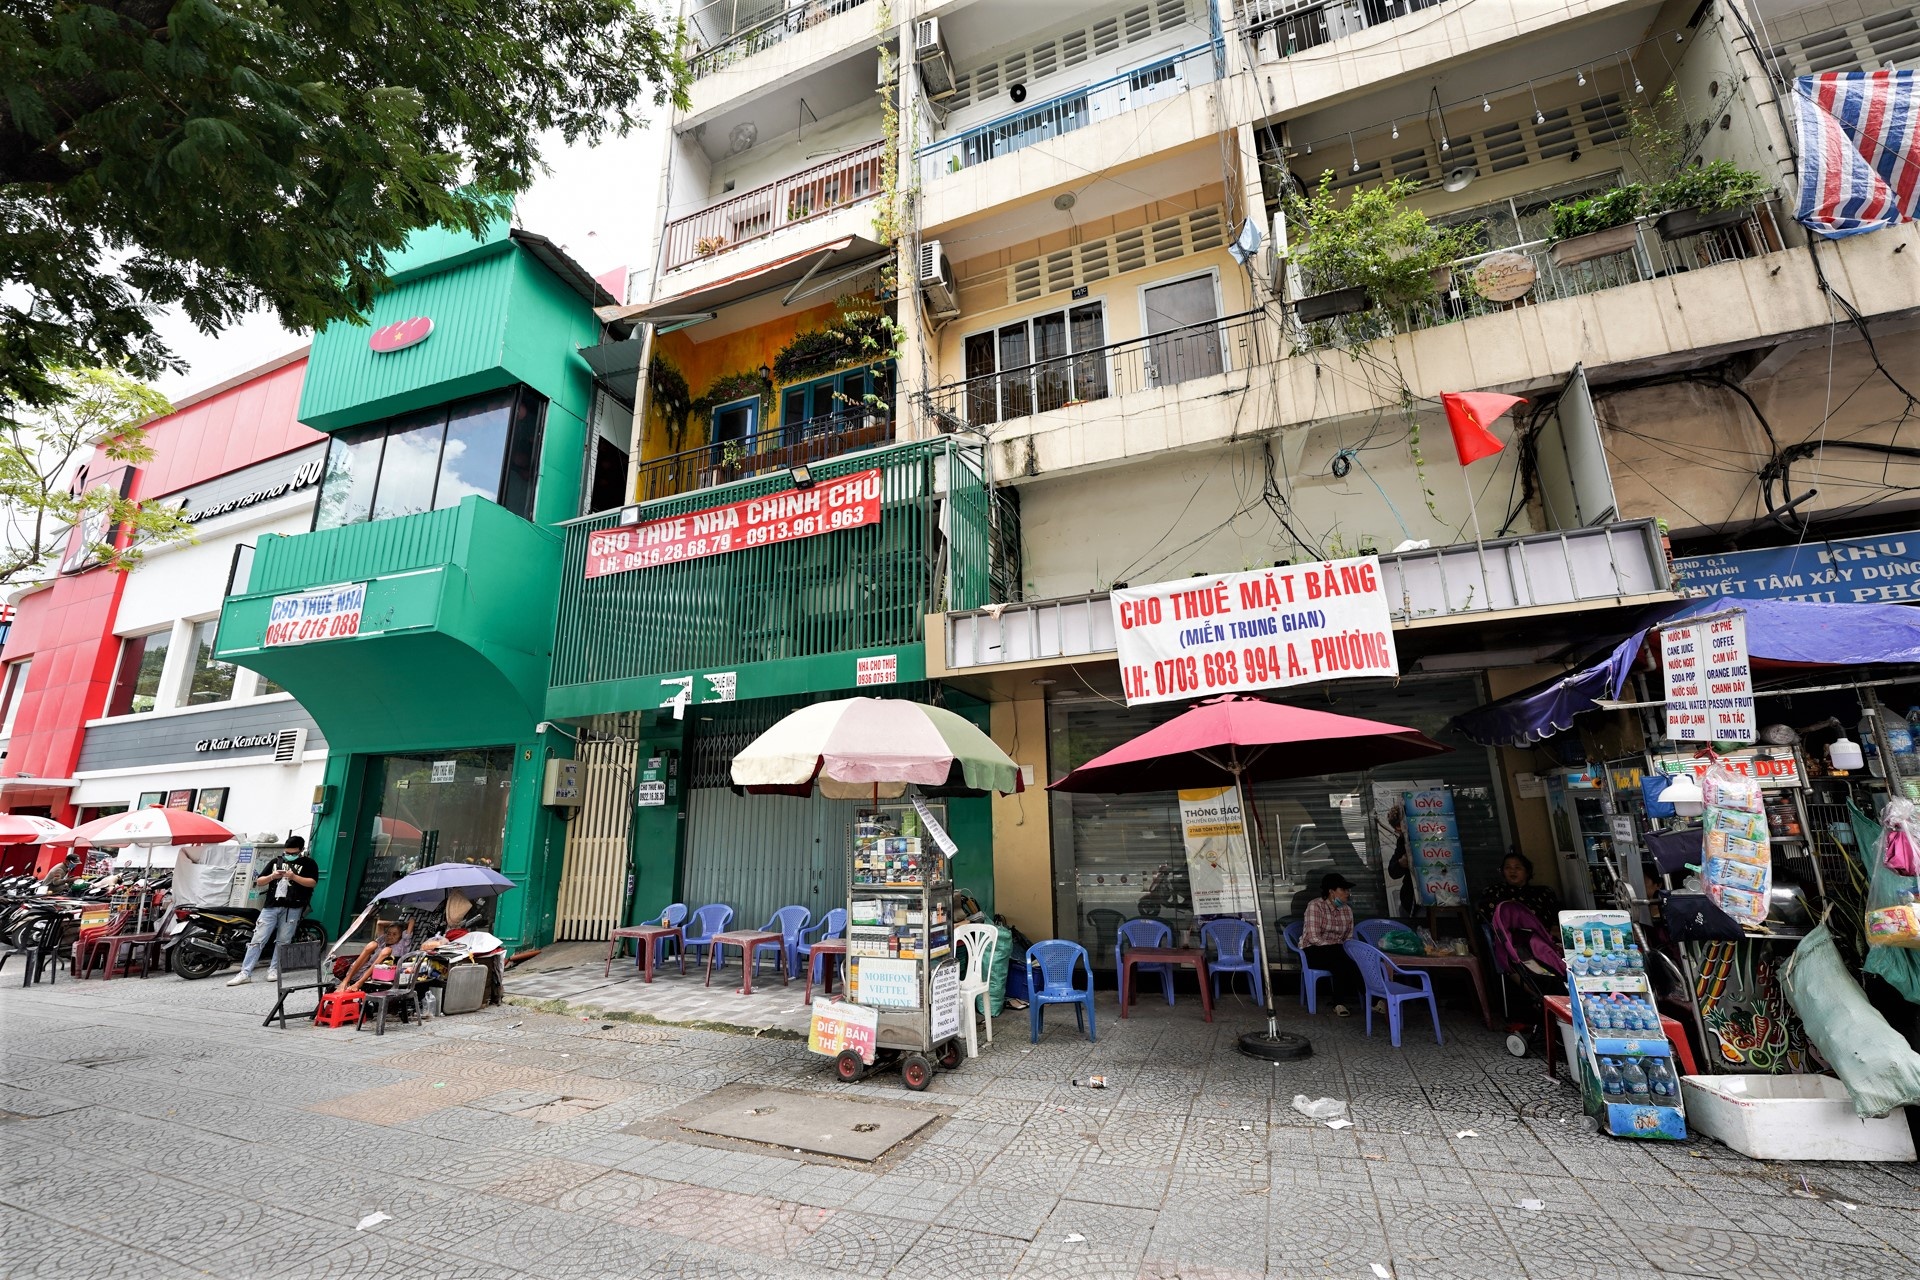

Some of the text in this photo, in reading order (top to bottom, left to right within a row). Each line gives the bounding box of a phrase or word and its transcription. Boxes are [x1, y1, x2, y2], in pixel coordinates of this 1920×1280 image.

[591, 532, 630, 557] CHO
[828, 470, 880, 508] CHỦ
[600, 557, 620, 574] LH:
[625, 533, 731, 569] 0916.28.68.79
[746, 506, 864, 545] 0913.961.963
[1817, 542, 1907, 564] KHU
[1698, 566, 1740, 578] THÀNH
[1753, 574, 1803, 590] TÂM
[1809, 568, 1854, 585] XÂY
[1120, 561, 1378, 630] CHO THUÊ MẶT BẰNG
[271, 599, 298, 621] CHO
[266, 613, 359, 645] 0847 016 088
[1179, 609, 1326, 649] (MIỄN TRUNG GIAN)
[1713, 636, 1734, 648] COFFEE
[1667, 643, 1694, 656] CANE JUICE
[870, 660, 881, 671] CHO
[882, 655, 896, 669] THUÊ
[1123, 628, 1391, 700] LH: 0703 683 994 A. PHƯƠNG
[1712, 652, 1726, 664] CAM
[1672, 672, 1695, 683] SODA POP
[1707, 665, 1748, 680] ORANGE JUICE
[1712, 683, 1732, 694] CHANH
[1666, 700, 1707, 711] MINERAL WATER
[1709, 697, 1752, 709] PASSION FRUIT
[1670, 715, 1678, 724] BIA
[1691, 714, 1705, 726] LẠNH
[1719, 711, 1731, 724] TRÀ
[1681, 729, 1695, 738] BEER
[1716, 729, 1751, 739] LEMON TEA
[195, 732, 279, 752] Gà Rán Kentucky
[524, 750, 531, 760] 8
[1755, 759, 1795, 777] DUY
[1185, 805, 1240, 818] THÔNG BÁO
[865, 972, 913, 984] MOBIFONE
[870, 984, 908, 995] VIETTEL
[865, 996, 912, 1007] VINAFONE
[817, 1020, 869, 1042] ĐIỂM BÁN
[818, 1036, 864, 1056] THẺ CÀO
